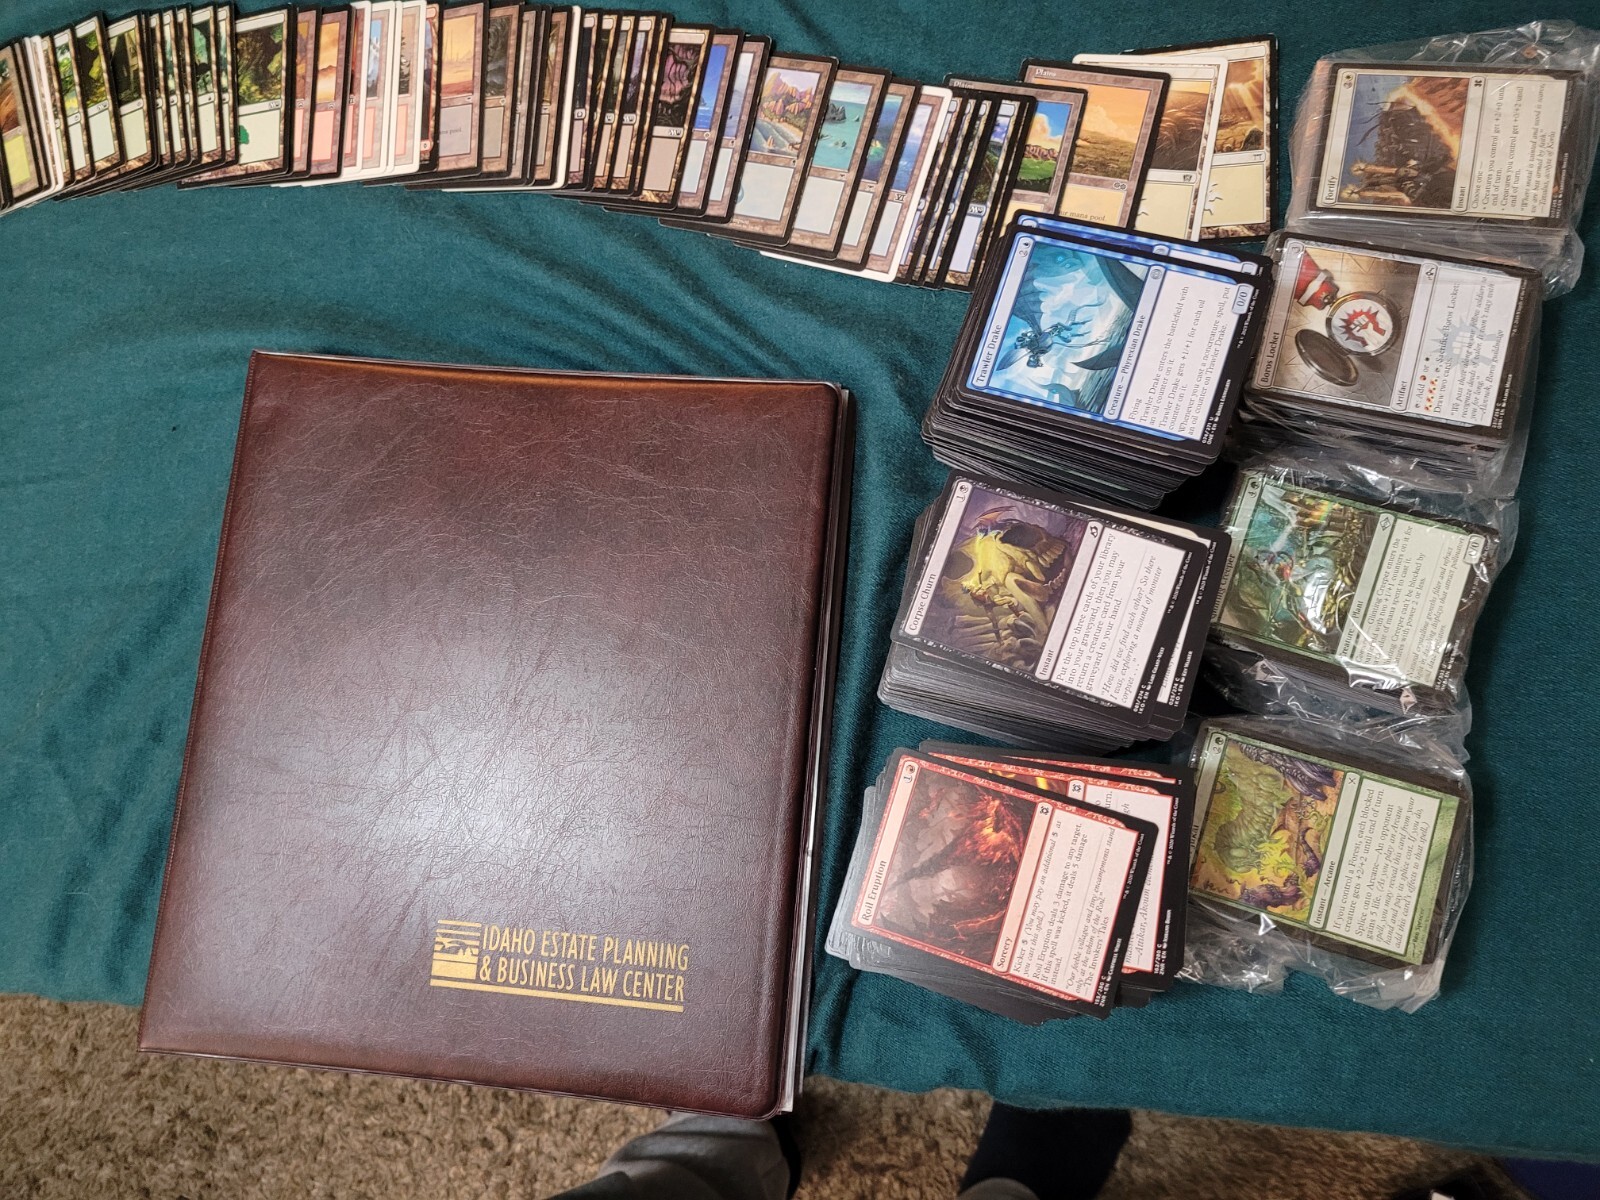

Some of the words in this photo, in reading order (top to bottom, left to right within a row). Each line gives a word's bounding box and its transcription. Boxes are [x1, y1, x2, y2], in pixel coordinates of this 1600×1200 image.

[1035, 68, 1057, 77] Plains
[1492, 123, 1500, 133] get
[1488, 135, 1498, 157] control
[1325, 176, 1337, 200] Fortify
[1456, 186, 1466, 208] Instant
[1471, 184, 1481, 208] Choose
[1482, 173, 1492, 204] Creatures
[1178, 285, 1189, 300] with
[1220, 286, 1232, 299] put
[1235, 290, 1248, 307] 0/0
[1196, 299, 1205, 308] oil
[1214, 299, 1227, 318] spell,
[1167, 302, 1184, 336] battlefield
[1191, 309, 1202, 325] each
[1187, 327, 1196, 337] for
[1201, 319, 1220, 360] noncreature
[976, 350, 993, 383] Trawler
[987, 324, 1002, 349] Drake
[1163, 337, 1173, 349] the
[1180, 339, 1193, 360] +1/+1
[1266, 331, 1279, 358] Locket
[1107, 383, 1123, 415] Creature
[1120, 337, 1140, 374] Phyrexian
[1133, 314, 1146, 335] Drake
[1155, 350, 1168, 371] enters
[1175, 361, 1187, 376] gets
[1260, 359, 1273, 382] Boros
[1442, 356, 1452, 377] cards.
[1148, 372, 1161, 394] Drake
[1194, 368, 1204, 382] cast
[1439, 379, 1448, 391] two
[1167, 377, 1181, 399] Drake
[1191, 383, 1201, 397] you
[1395, 380, 1407, 406] Artifact
[1416, 383, 1425, 398] Add
[1128, 397, 1142, 420] Flying
[1139, 396, 1154, 423] Trawler
[1434, 393, 1444, 413] Draw
[1158, 400, 1173, 428] Trawler
[1178, 398, 1195, 433] Whenever
[1099, 532, 1116, 560] library
[1416, 551, 1426, 561] by
[1094, 560, 1107, 579] your
[1108, 550, 1120, 568] may
[1219, 553, 1236, 586] Creeper
[1088, 578, 1098, 589] of
[1102, 569, 1114, 585] you
[1367, 597, 1383, 625] Glinting
[1376, 570, 1392, 596] Creeper
[1385, 549, 1397, 569] enters
[1391, 537, 1400, 548] the
[1408, 561, 1422, 588] blocked
[908, 600, 927, 632] Corpse
[919, 572, 936, 599] Churn
[1080, 590, 1094, 612] cards
[1093, 585, 1106, 604] then
[1405, 588, 1414, 597] be
[1108, 596, 1122, 619] hand.
[1351, 600, 1363, 619] Plant
[1072, 613, 1086, 634] three
[1074, 661, 1089, 687] return
[1086, 620, 1104, 653] creature
[1098, 600, 1111, 618] card
[1105, 579, 1118, 599] from
[1114, 559, 1127, 579] your
[1079, 605, 1101, 647] graveyard,
[1103, 621, 1116, 640] your
[1391, 615, 1406, 642] Creeper
[1067, 635, 1080, 650] top
[1097, 641, 1107, 650] to
[1039, 648, 1054, 675] Instant
[1062, 651, 1073, 664] the
[1073, 647, 1086, 667] your
[1056, 665, 1067, 681] Put
[1065, 667, 1077, 684] into
[1083, 651, 1105, 691] graveyard
[1360, 787, 1374, 819] blocked
[1374, 787, 1384, 808] turn.
[1370, 807, 1379, 817] of
[1070, 822, 1084, 846] target.
[1355, 819, 1366, 838] each
[1367, 818, 1376, 834] end
[1068, 847, 1077, 860] any
[1074, 833, 1090, 862] damage
[1348, 838, 1363, 868] Forest,
[1362, 835, 1373, 854] until
[1063, 860, 1072, 869] to
[1354, 911, 1368, 937] Splice
[1362, 891, 1372, 910] onto
[1379, 803, 1395, 841] opponent
[1355, 855, 1368, 880] +2/+2
[867, 859, 888, 900] Eruption
[1055, 870, 1070, 900] damage
[1066, 869, 1078, 888] deals
[1314, 897, 1327, 925] Instant
[1323, 859, 1336, 887] Arcane
[1339, 875, 1353, 904] control
[1351, 882, 1362, 899] gets
[861, 900, 874, 921] Roil
[1056, 896, 1071, 924] kicked,
[1136, 888, 1153, 920] Akoum
[1337, 905, 1347, 920] you
[1047, 907, 1058, 927] deals
[1098, 915, 1110, 934] Tales
[1333, 920, 1342, 929] If
[1344, 900, 1357, 932] creature
[1365, 918, 1377, 940] gains
[1371, 893, 1381, 909] life.
[1053, 925, 1062, 939] was
[482, 926, 536, 956] IDAHO
[540, 930, 597, 962] ESTATE
[602, 936, 690, 971] PLANNING
[996, 935, 1013, 968] Sorcery
[1037, 928, 1054, 962] Eruption
[1046, 940, 1059, 959] spell
[1012, 946, 1026, 972] Kicker
[1042, 959, 1052, 973] this
[479, 955, 491, 982] &
[496, 959, 575, 991] BUSINESS
[580, 966, 617, 994] LAW
[622, 970, 685, 1002] CENTER
[1032, 962, 1043, 979] Roil
[1040, 971, 1049, 982] If
[1048, 955, 1063, 985] instead.
